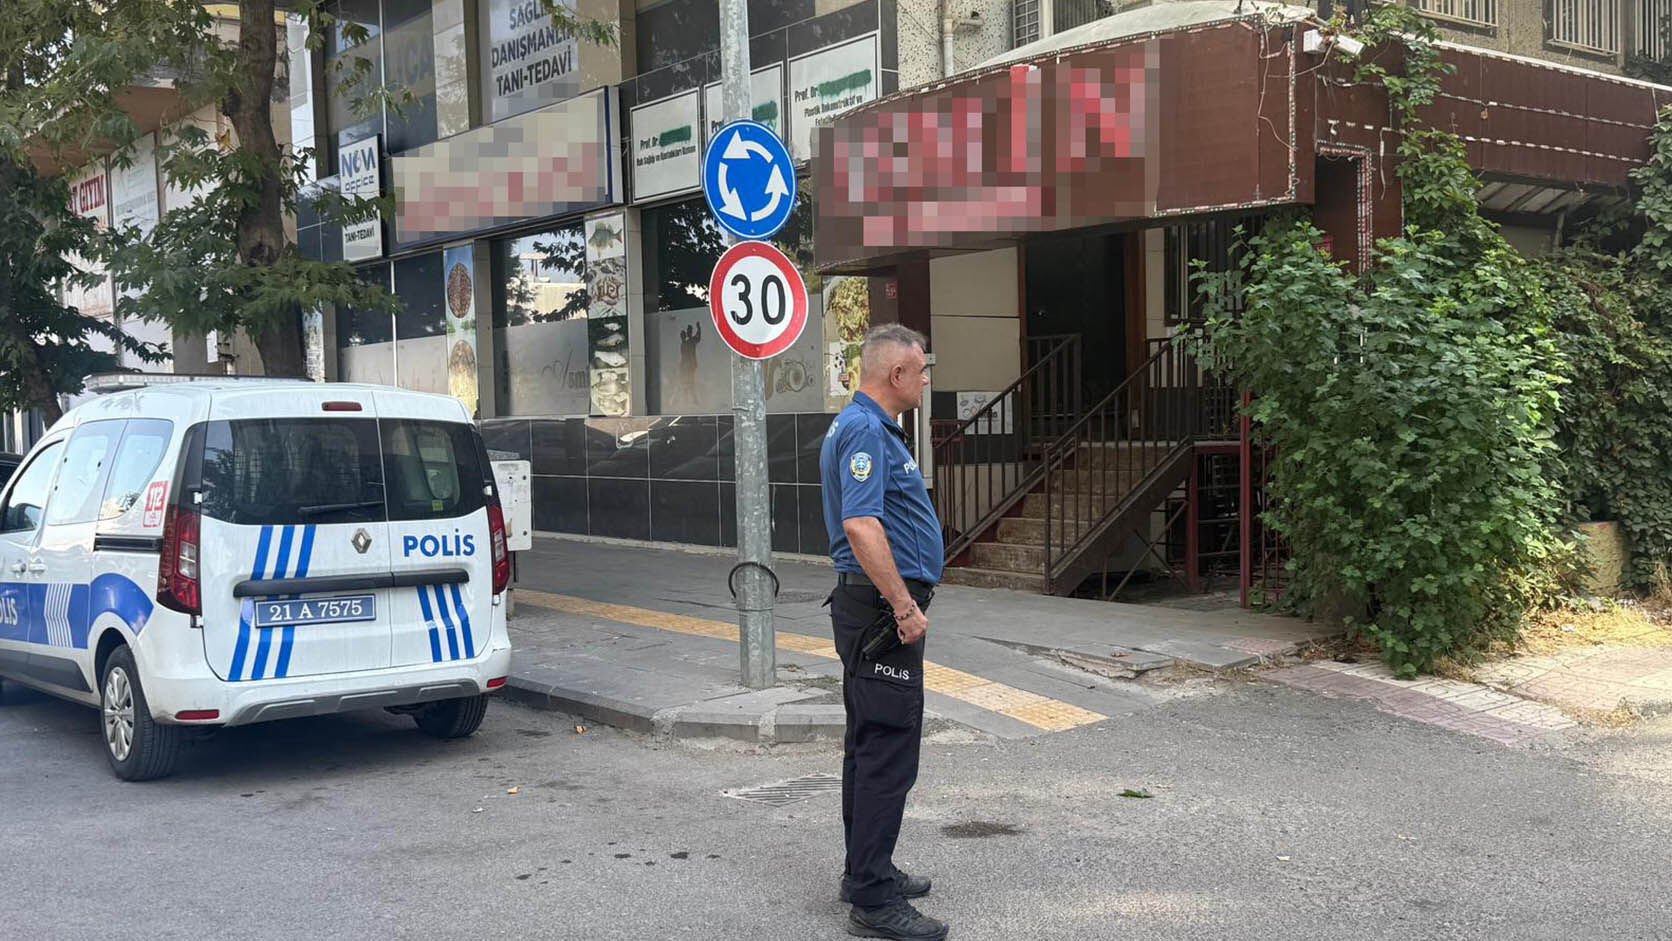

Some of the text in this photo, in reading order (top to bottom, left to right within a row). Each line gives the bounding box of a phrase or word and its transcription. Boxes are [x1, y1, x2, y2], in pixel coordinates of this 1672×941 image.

[496, 44, 572, 97] TANI-TEDAVİ
[731, 273, 786, 326] 30
[403, 528, 476, 558] POLİS
[269, 599, 363, 621] 21 A 7575
[874, 663, 910, 680] POLİS
